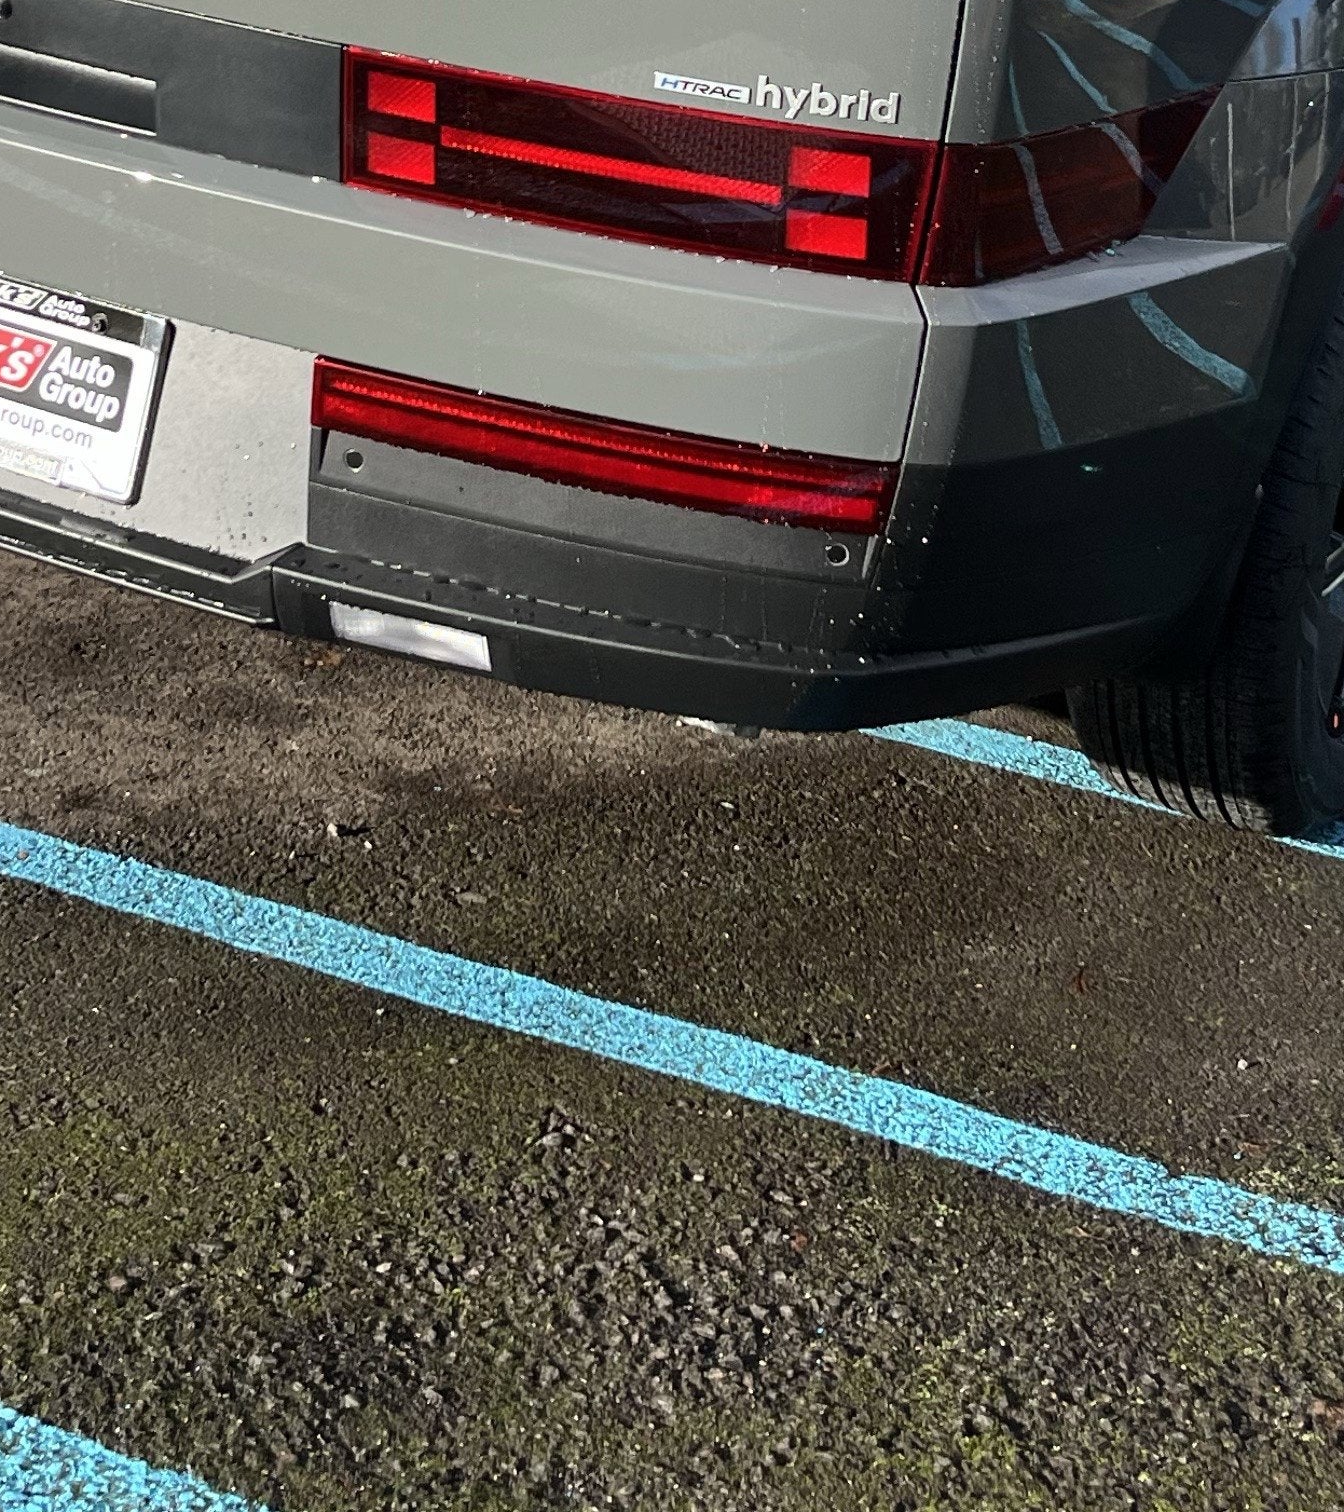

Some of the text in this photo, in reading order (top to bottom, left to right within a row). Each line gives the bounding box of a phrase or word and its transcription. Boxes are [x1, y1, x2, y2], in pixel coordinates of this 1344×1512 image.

[659, 74, 902, 125] HTRAC hybrid
[38, 302, 92, 327] Group
[47, 294, 86, 314] Auto
[48, 345, 116, 388] Auto
[38, 372, 121, 424] Group
